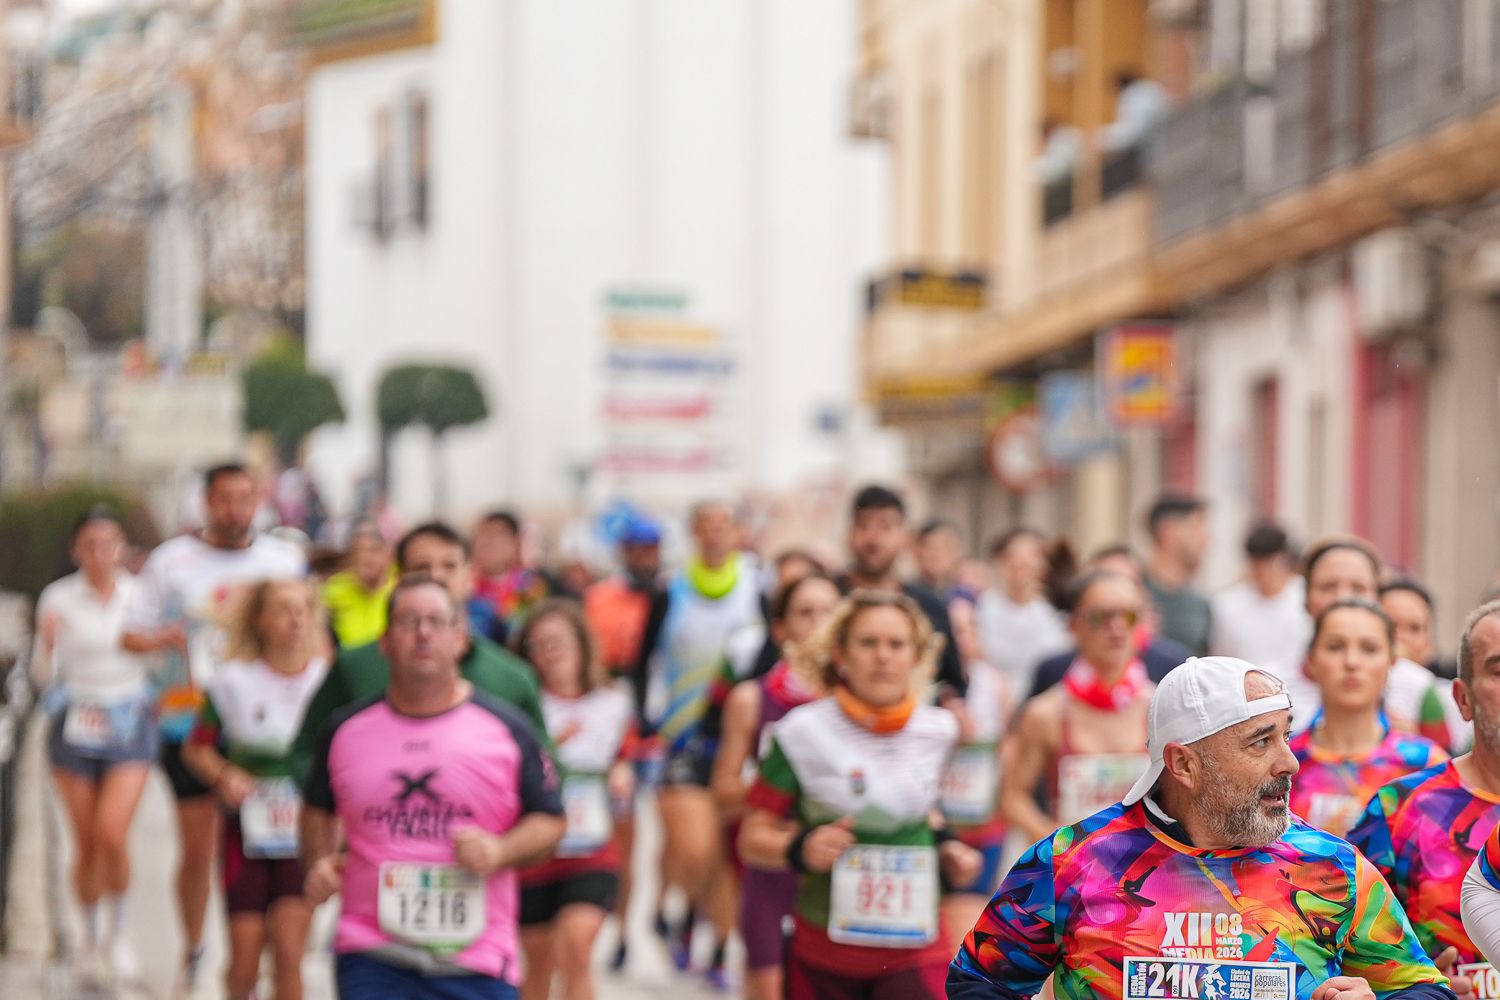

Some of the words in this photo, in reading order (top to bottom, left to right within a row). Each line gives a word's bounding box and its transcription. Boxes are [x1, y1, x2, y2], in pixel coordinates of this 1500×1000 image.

[1161, 912, 1213, 947] XII
[1214, 913, 1243, 936] 08
[1216, 937, 1243, 946] MARZO
[1216, 947, 1244, 959] 2026
[1148, 963, 1200, 998] 21K
[1254, 975, 1281, 983] carreras
[1254, 979, 1286, 988] populares
[1230, 988, 1250, 999] 2026
